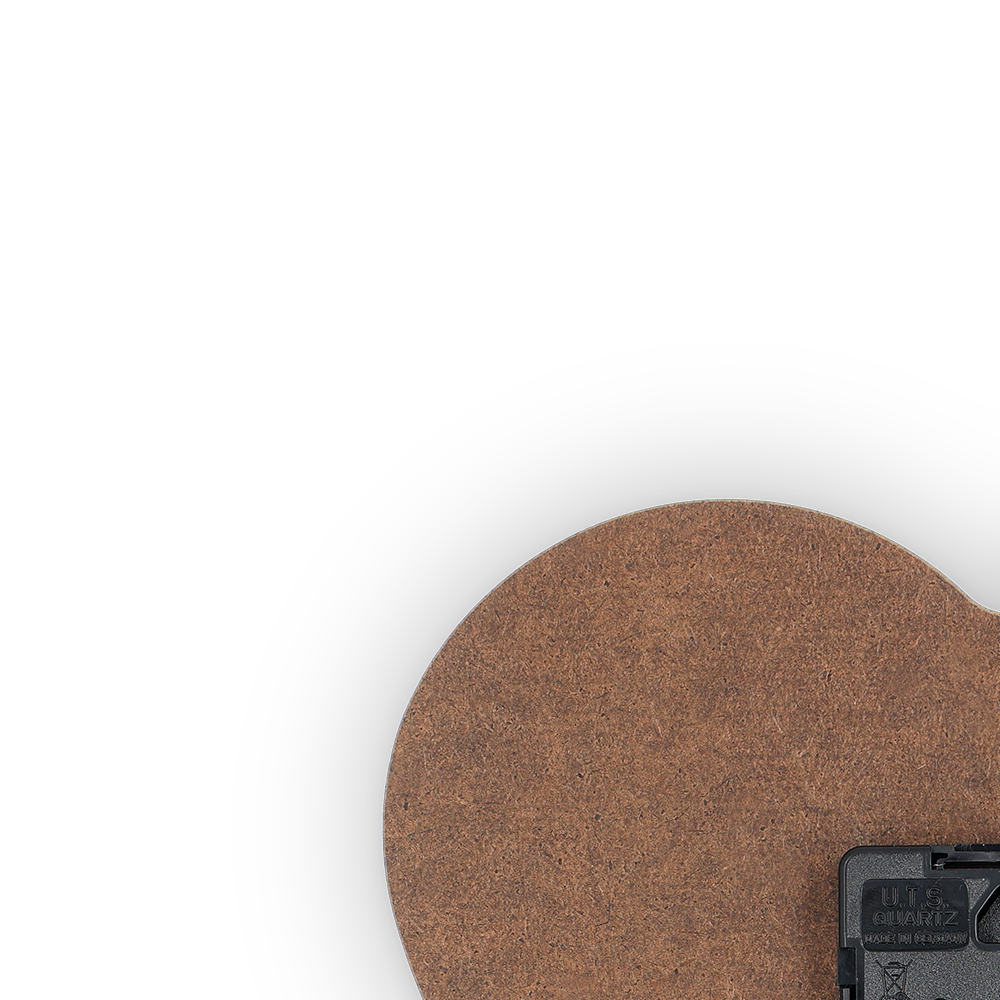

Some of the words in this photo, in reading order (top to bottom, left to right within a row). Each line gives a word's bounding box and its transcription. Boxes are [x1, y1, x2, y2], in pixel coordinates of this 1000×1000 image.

[881, 885, 949, 908] U.T.S.
[872, 910, 959, 927] QUARTZ
[864, 932, 896, 945] MADE
[898, 932, 912, 945] IN
[914, 931, 968, 945] GERMANY
